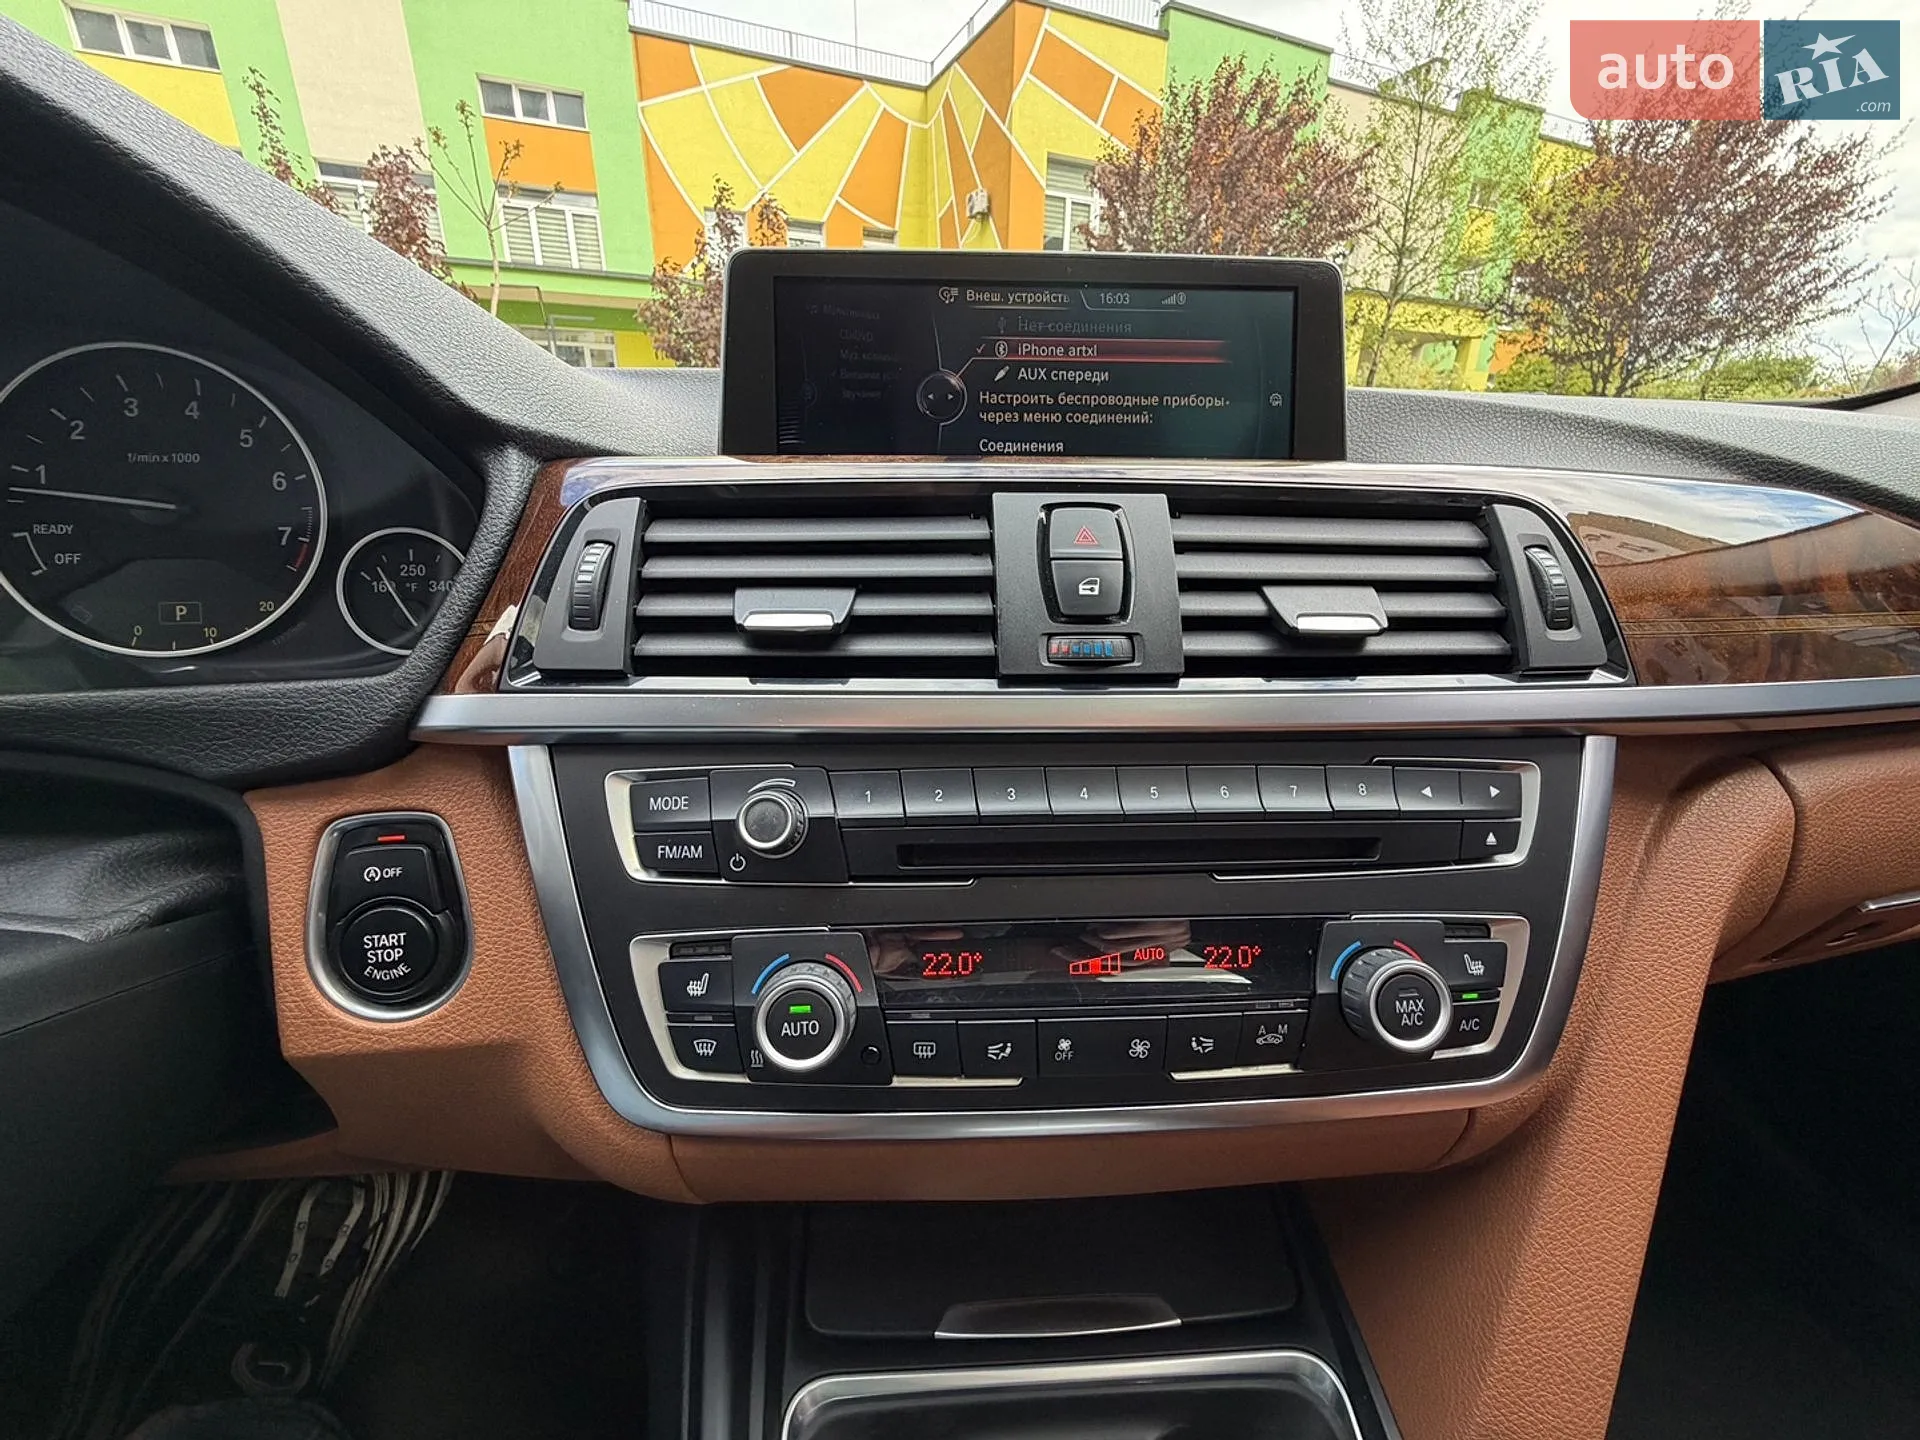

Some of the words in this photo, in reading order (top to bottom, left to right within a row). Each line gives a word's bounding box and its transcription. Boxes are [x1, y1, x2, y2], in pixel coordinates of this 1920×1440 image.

[966, 289, 1003, 303] Внеш.
[1100, 292, 1130, 305] 16:03
[1018, 318, 1042, 333] Нет
[1047, 320, 1132, 335] соединения
[1018, 343, 1064, 357] iPhone
[1018, 368, 1047, 381] AUX
[1051, 370, 1109, 385] спереди
[979, 391, 1053, 406] Настроить
[1058, 391, 1159, 407] беспроводные
[124, 398, 139, 417] 3
[184, 400, 200, 419] 4
[979, 411, 1019, 425] через
[1023, 412, 1062, 424] меню
[1066, 409, 1153, 426] соединений:
[69, 420, 85, 440] 2
[239, 428, 253, 448] 5
[979, 438, 1064, 453] Соединения
[127, 452, 160, 465] 1/min
[171, 452, 201, 464] 1000
[35, 464, 47, 484] 1
[271, 471, 287, 491] 6
[33, 523, 74, 536] READY
[277, 526, 292, 546] 7
[54, 552, 81, 565] OFF
[400, 563, 426, 577] 250
[175, 605, 188, 621] P
[259, 600, 275, 612] 20
[133, 624, 143, 637] 0
[203, 626, 217, 639] 10
[864, 789, 872, 803] 1
[934, 788, 944, 803] 2
[1007, 787, 1016, 801] 3
[1079, 786, 1089, 801] 4
[1150, 785, 1159, 800] 5
[1221, 784, 1230, 800] 6
[1289, 784, 1298, 798] 7
[1357, 782, 1367, 797] 8
[649, 795, 689, 812] MODE
[657, 844, 703, 861] FM/AM
[382, 866, 403, 879] OFF
[363, 932, 407, 949] START
[366, 948, 404, 964] STOP
[1134, 947, 1165, 961] AUTO
[364, 962, 411, 981] ENGINE
[1395, 999, 1425, 1014] MAX
[1400, 1012, 1424, 1027] A/C
[1459, 1018, 1480, 1032] A/C
[780, 1020, 819, 1038] AUTO
[1054, 1050, 1074, 1063] OFF
